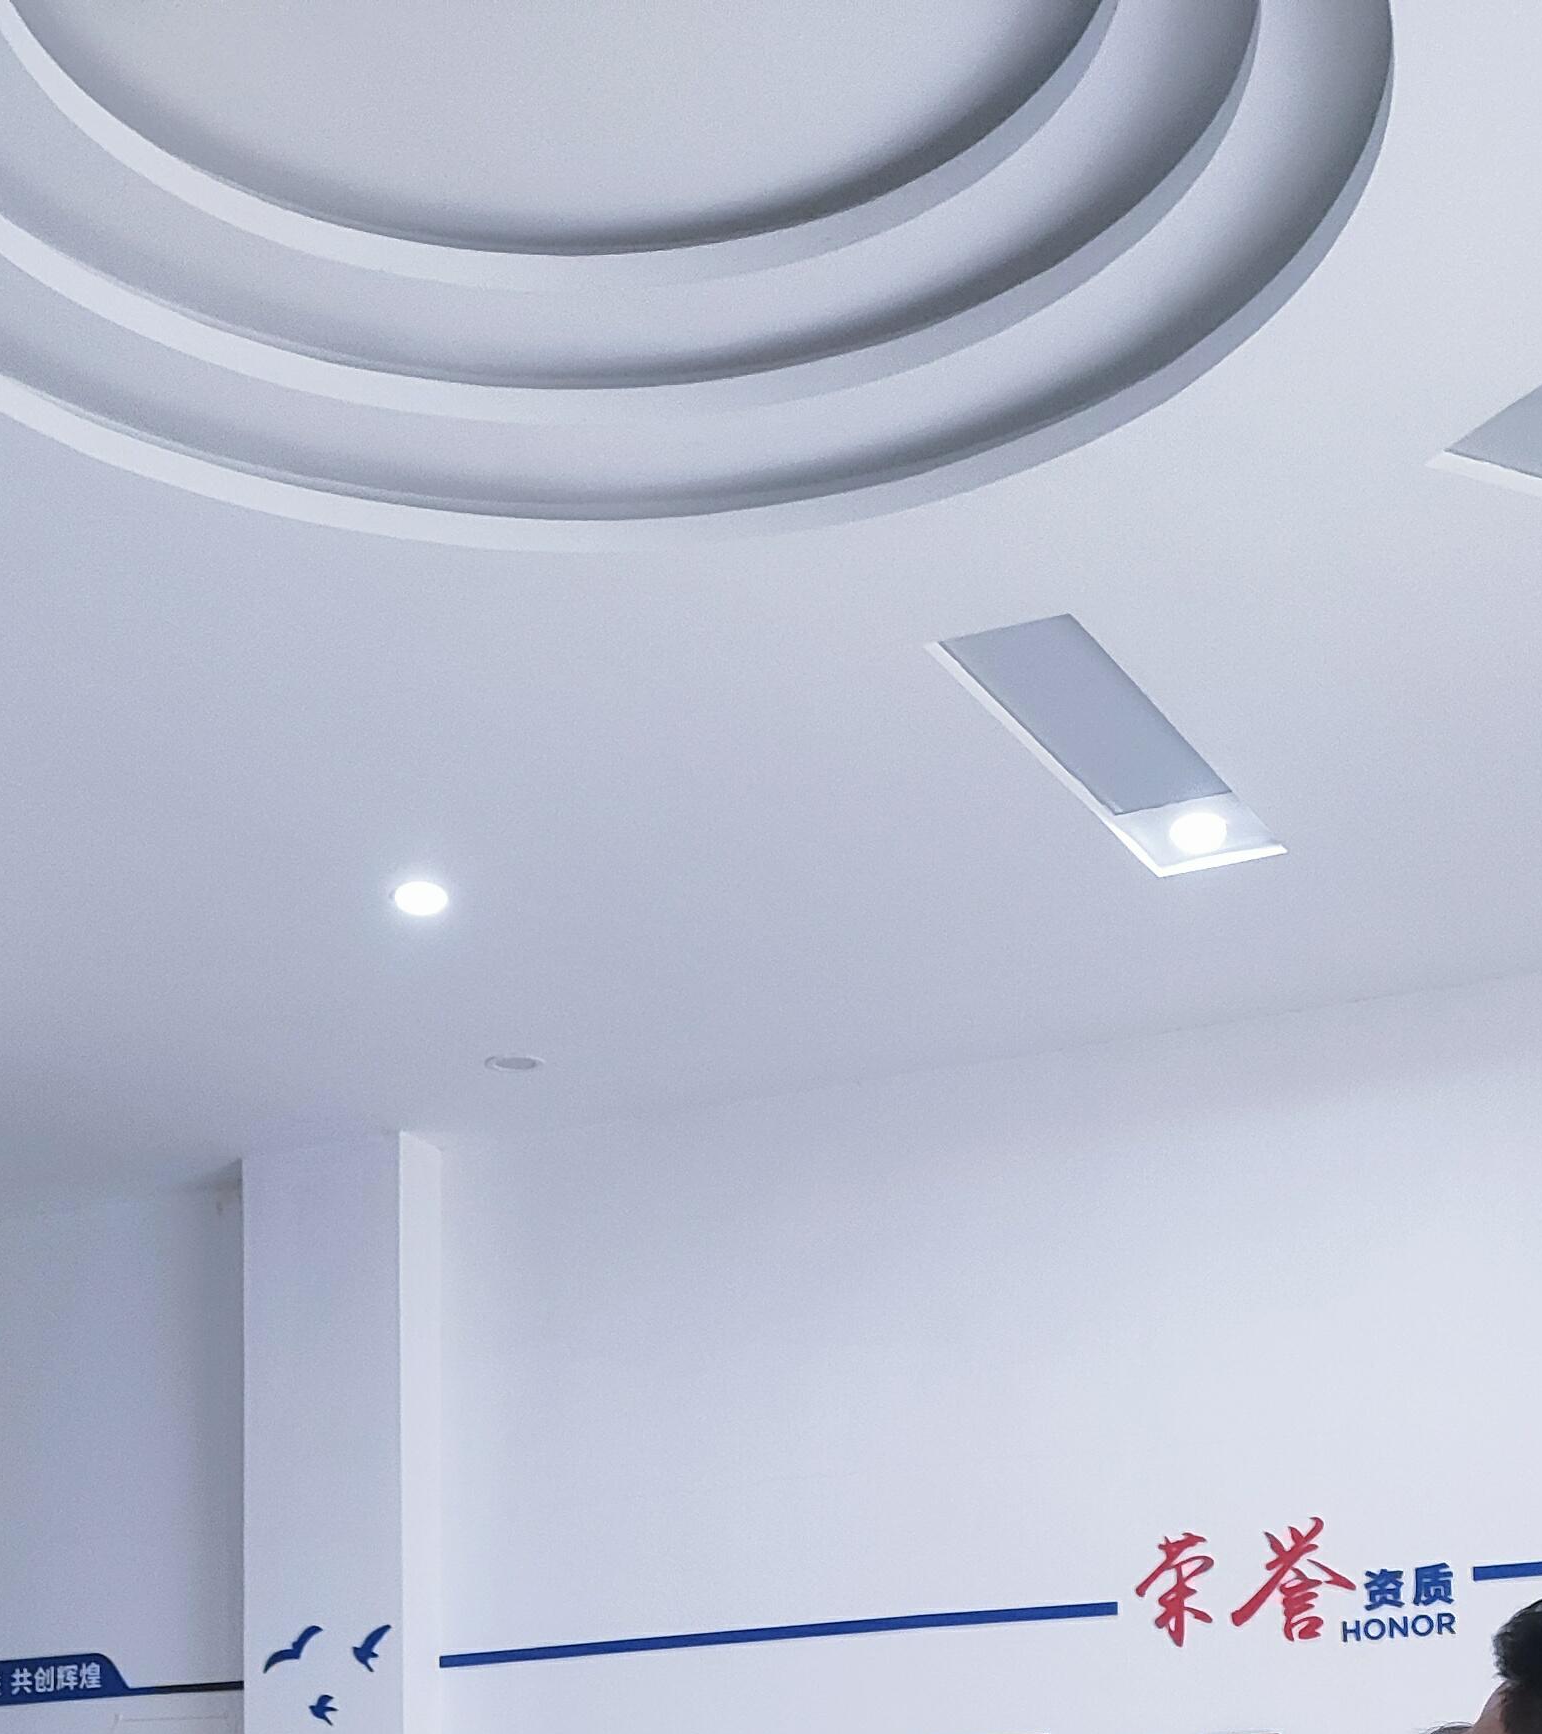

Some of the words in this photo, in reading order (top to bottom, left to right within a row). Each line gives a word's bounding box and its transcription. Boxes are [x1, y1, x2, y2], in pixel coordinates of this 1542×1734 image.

[1135, 1517, 1357, 1648] 荣誉
[1363, 1562, 1454, 1610] 资质
[1342, 1612, 1457, 1643] HONOR
[10, 1662, 102, 1695] 共创辉煌
